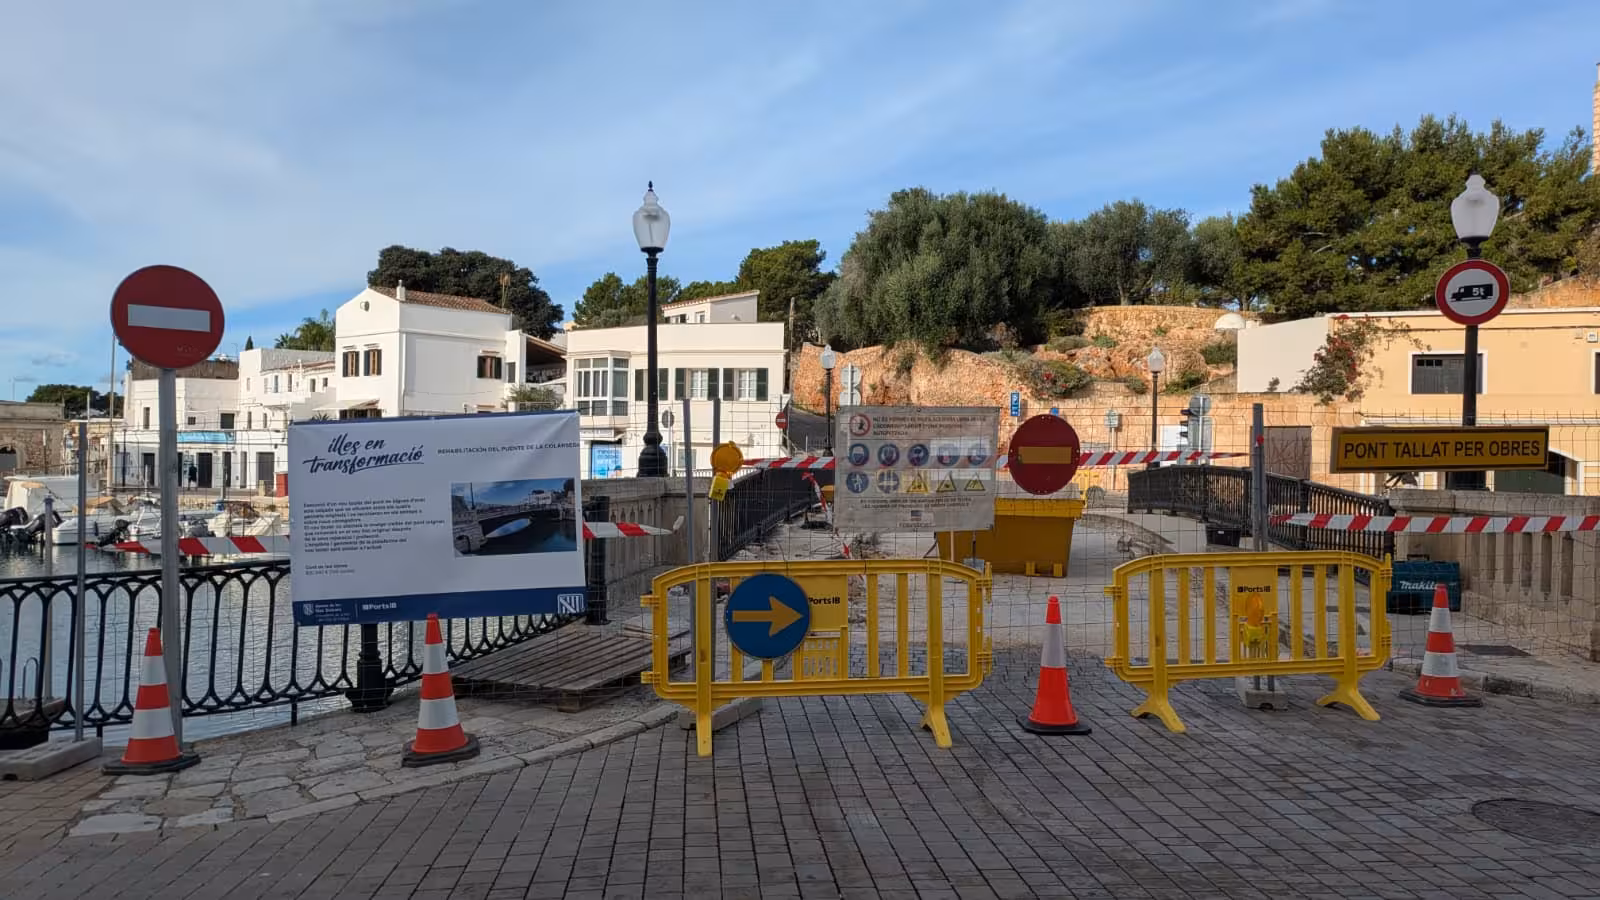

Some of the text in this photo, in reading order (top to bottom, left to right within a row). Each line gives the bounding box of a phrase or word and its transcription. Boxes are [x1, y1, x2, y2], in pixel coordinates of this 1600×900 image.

[327, 433, 385, 455] illes en
[1344, 440, 1540, 459] PONT TALLAT PER OBRES
[302, 444, 424, 474] transformació
